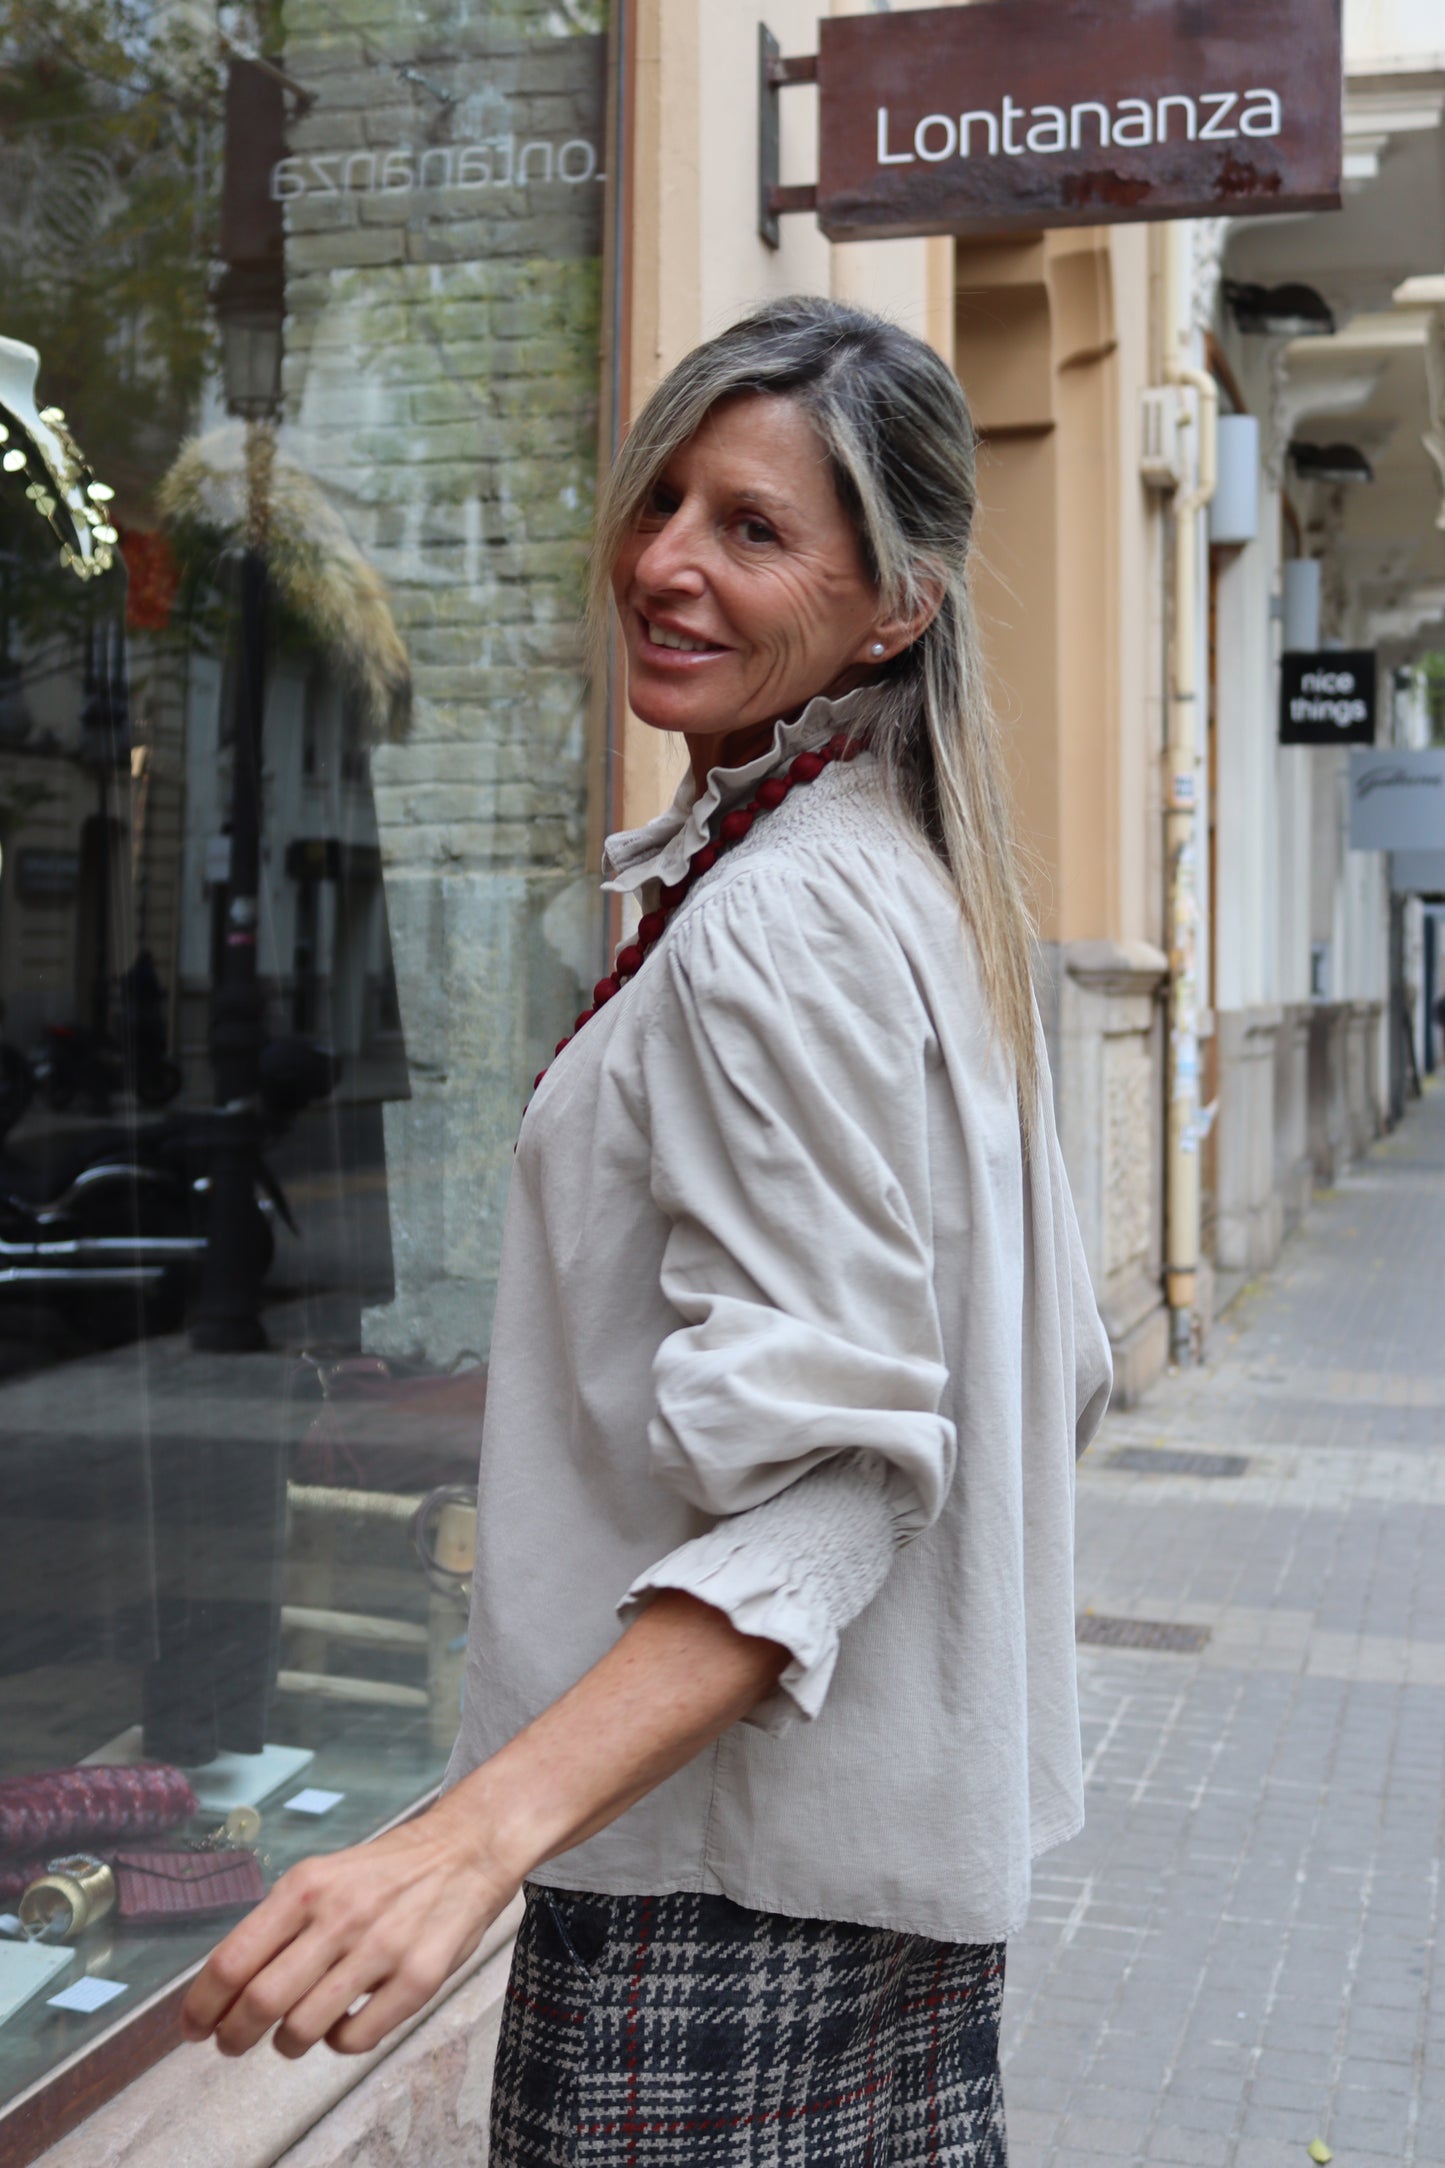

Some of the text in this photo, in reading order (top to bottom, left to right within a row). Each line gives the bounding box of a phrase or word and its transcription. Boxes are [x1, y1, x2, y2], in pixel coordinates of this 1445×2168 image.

[877, 88, 1282, 165] Lontananza
[1301, 667, 1355, 695] nice
[1290, 695, 1367, 728] things
